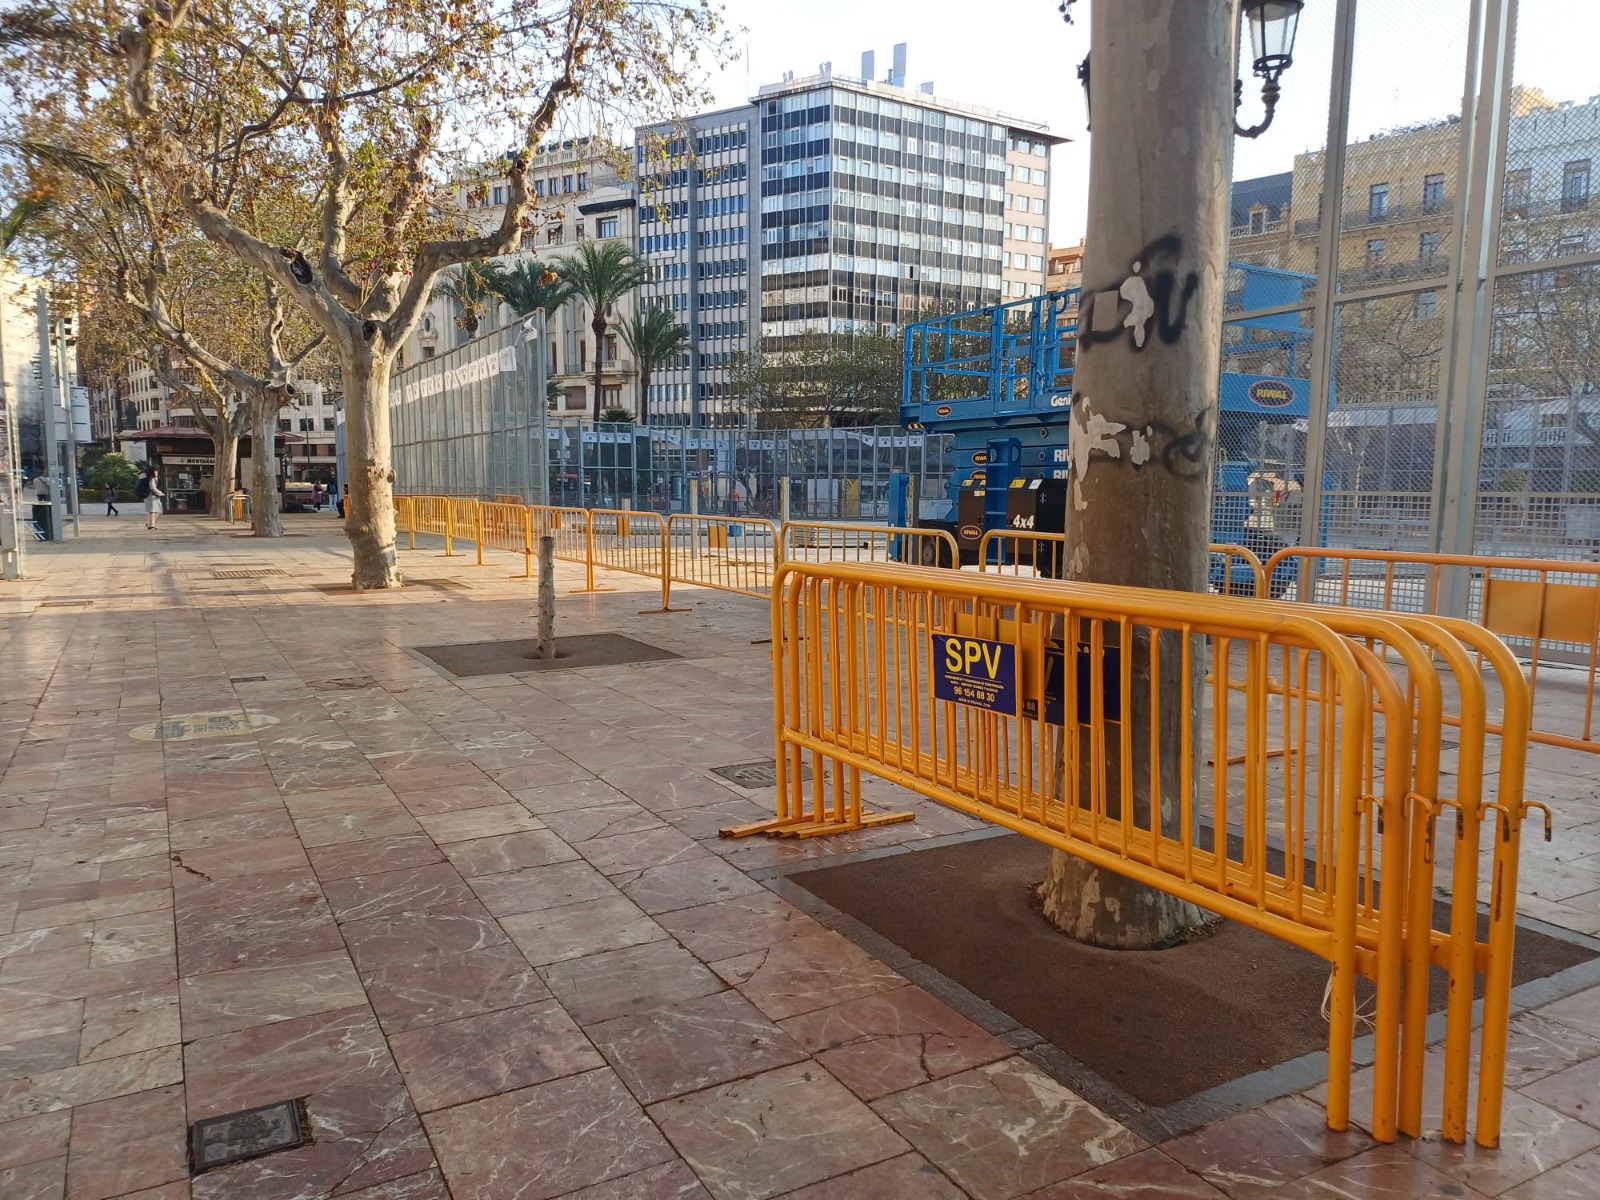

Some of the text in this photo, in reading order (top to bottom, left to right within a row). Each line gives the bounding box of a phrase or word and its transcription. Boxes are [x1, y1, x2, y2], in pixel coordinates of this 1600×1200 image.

[1051, 395, 1071, 407] Geni
[1257, 389, 1288, 400] RIWAL
[1013, 515, 1034, 528] 4x4
[946, 638, 1001, 679] SPV
[954, 687, 995, 702] 96 154 88 30
